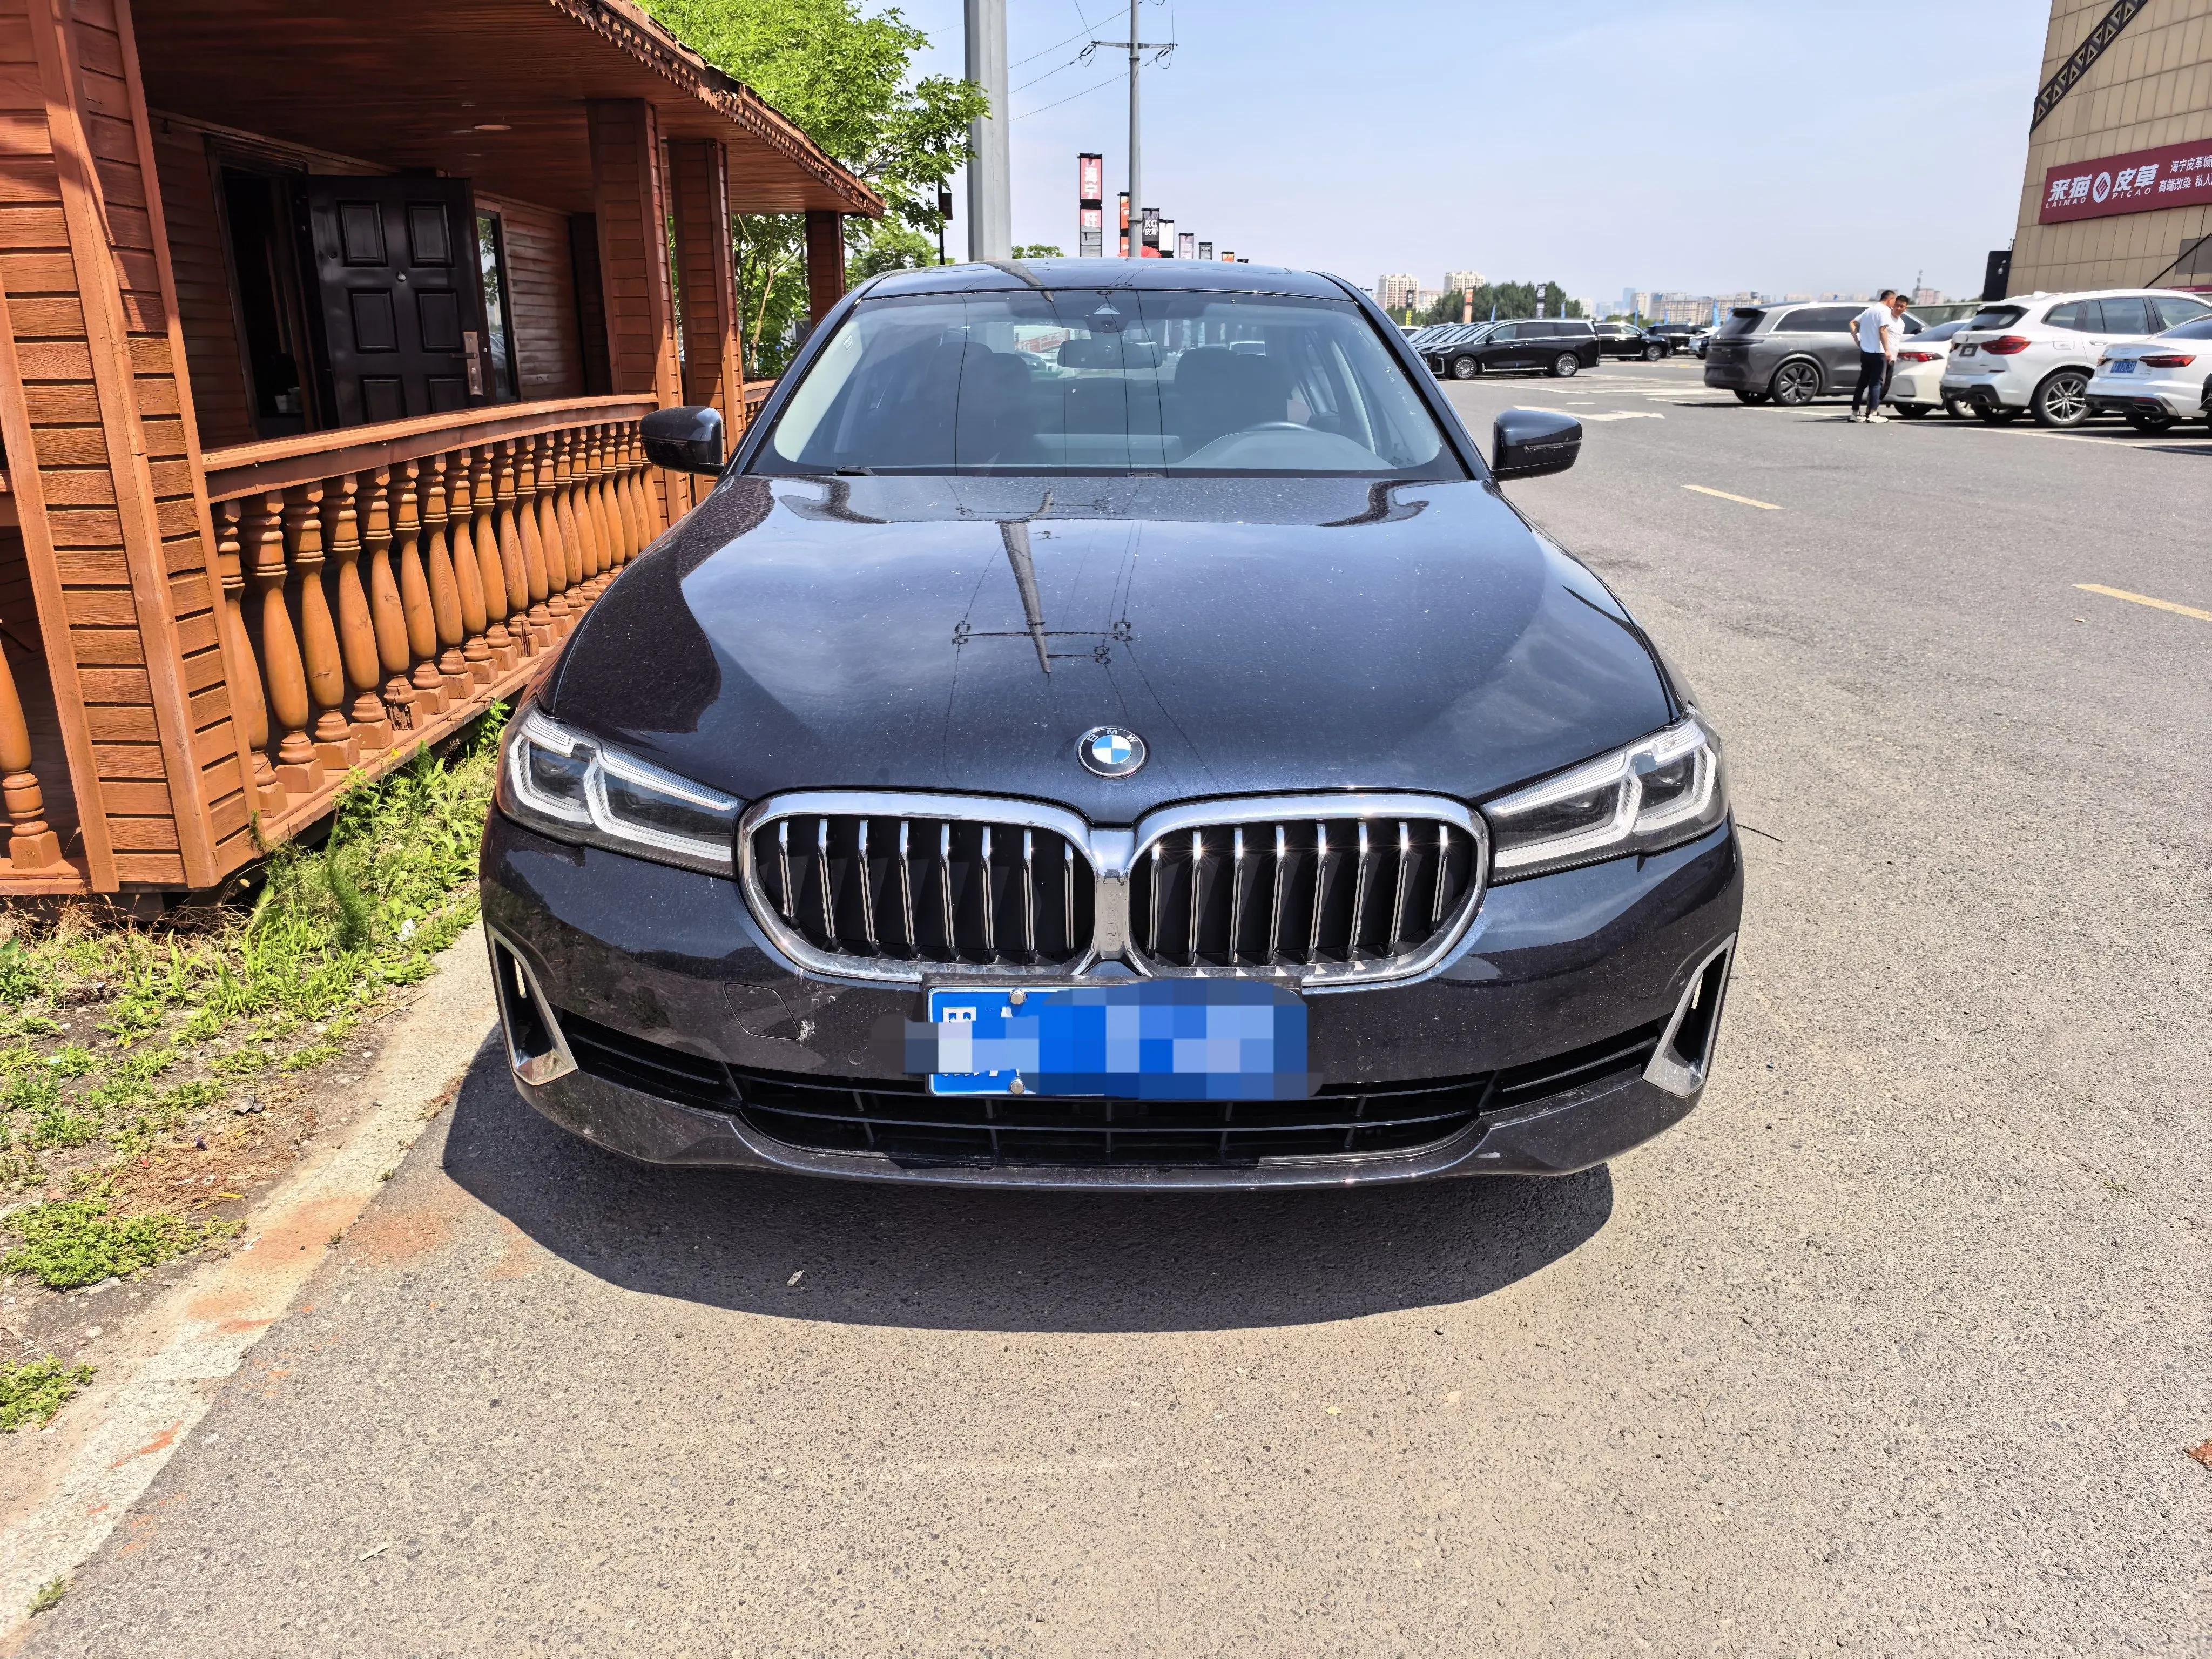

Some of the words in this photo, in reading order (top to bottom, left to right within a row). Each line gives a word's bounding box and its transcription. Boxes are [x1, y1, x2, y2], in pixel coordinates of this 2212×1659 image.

[2170, 154, 2212, 173] 海宁皮革城
[2112, 164, 2160, 192] 皮草
[2158, 176, 2191, 193] 高端改染
[2194, 173, 2212, 187] 私人
[2045, 197, 2087, 208] LAIMAO
[2112, 187, 2152, 199] PICAO
[1086, 729, 1138, 743] BMW
